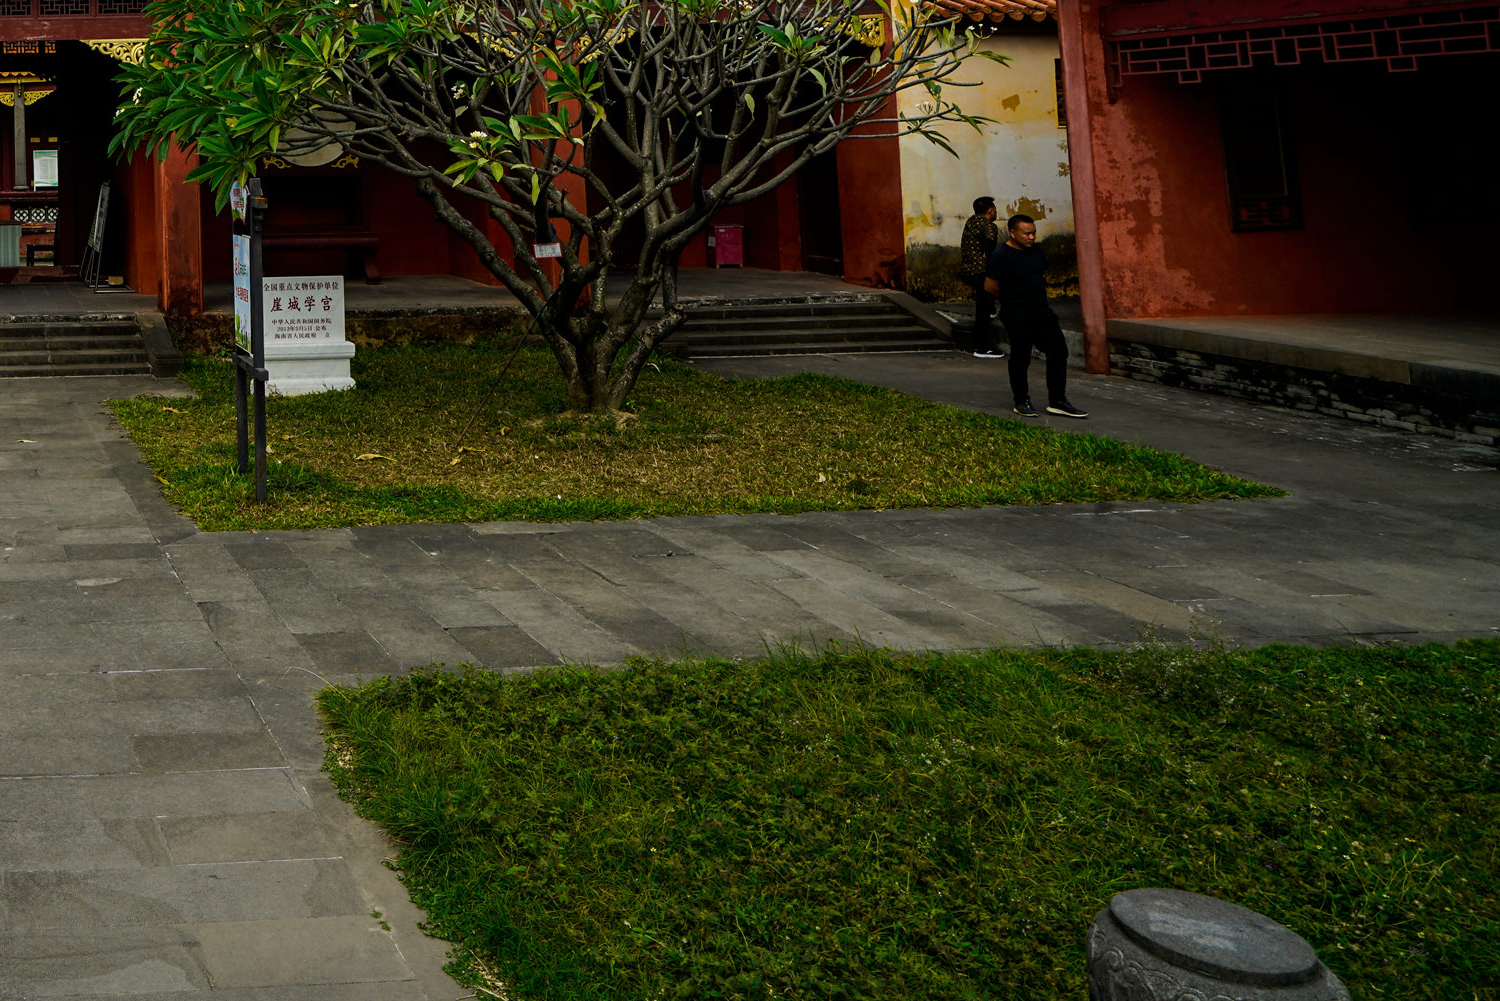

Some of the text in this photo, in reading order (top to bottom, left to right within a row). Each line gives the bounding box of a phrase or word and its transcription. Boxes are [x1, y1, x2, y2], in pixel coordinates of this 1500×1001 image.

[263, 281, 340, 292] 全国重点文物保护单位
[270, 295, 333, 313] 崖城学宫
